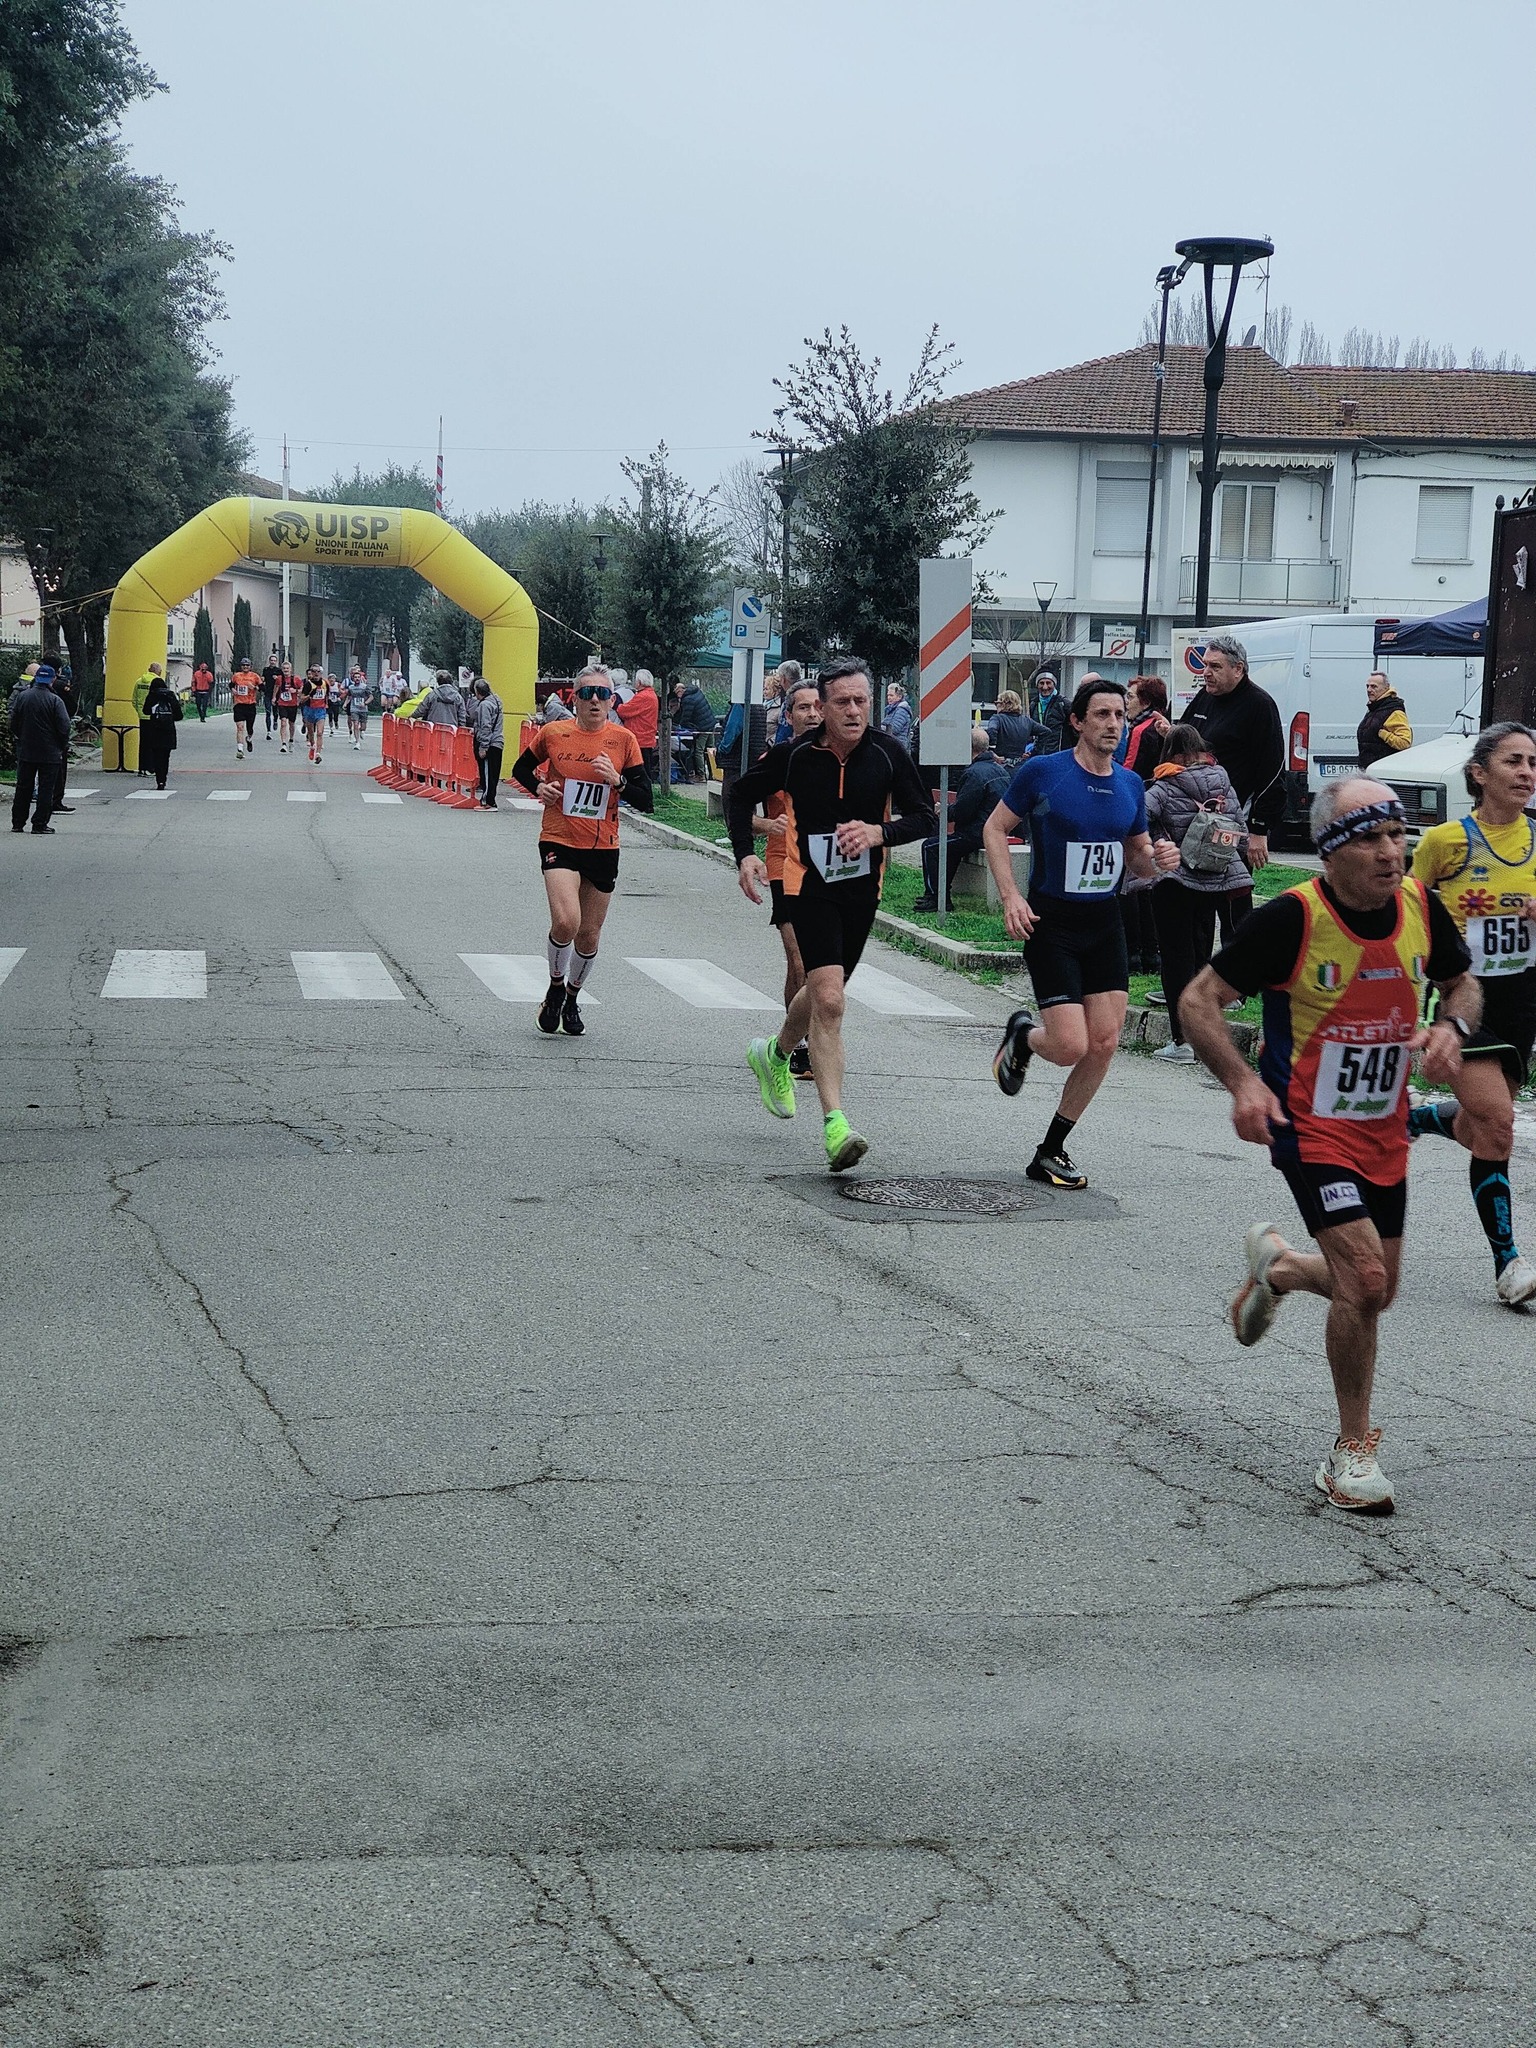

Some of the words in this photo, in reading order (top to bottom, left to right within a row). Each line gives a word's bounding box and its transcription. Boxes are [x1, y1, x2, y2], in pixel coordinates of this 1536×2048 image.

[316, 513, 389, 540] UISP
[315, 547, 341, 555] SPORT
[316, 539, 347, 548] UNIONE
[352, 541, 389, 551] ITALIANA
[737, 625, 745, 636] P
[574, 781, 604, 808] 770
[1080, 844, 1115, 876] 734
[1483, 917, 1530, 956] 655
[1336, 1044, 1400, 1094] 548
